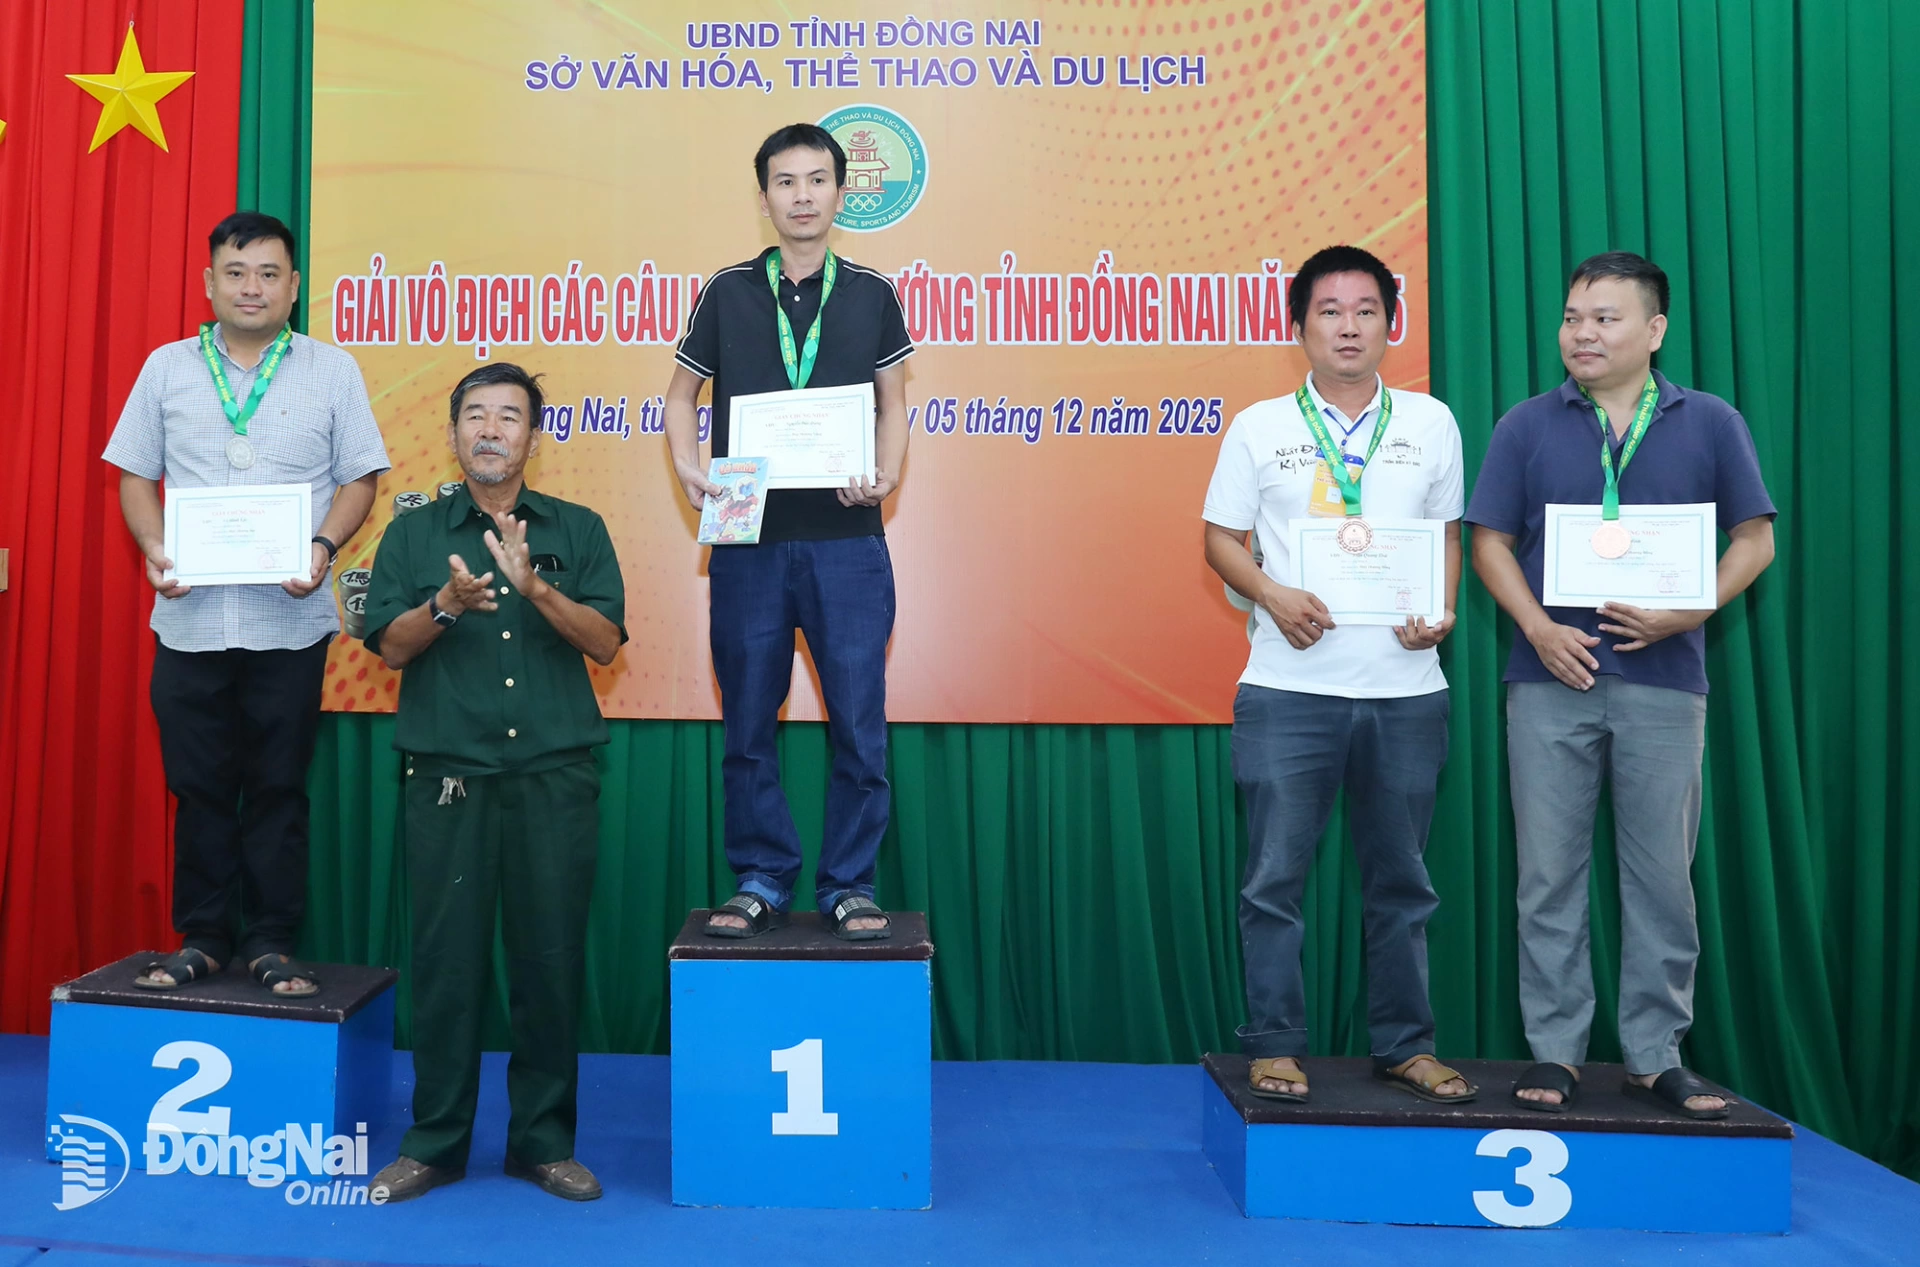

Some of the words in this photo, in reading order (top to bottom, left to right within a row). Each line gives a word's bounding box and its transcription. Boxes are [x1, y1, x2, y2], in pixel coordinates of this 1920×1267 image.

[687, 23, 780, 48] UBND
[790, 16, 866, 47] TỈNH
[875, 15, 975, 47] ĐỒNG
[985, 20, 1041, 46] NAI
[525, 55, 583, 90] SỞ
[591, 53, 668, 89] VĂN
[681, 52, 773, 93] HÓA,
[784, 52, 860, 87] THỂ
[870, 57, 977, 87] THAO
[987, 50, 1042, 86] VÀ
[1053, 56, 1105, 86] DU
[1118, 56, 1205, 92] LỊCH
[840, 113, 860, 123] THAO
[873, 114, 884, 122] DU
[884, 117, 900, 130] LỊCH
[911, 147, 920, 161] NAI
[860, 217, 888, 228] SPORTS
[888, 209, 901, 221] AND
[900, 183, 920, 211] TOURISM
[334, 254, 398, 344] GIẢI
[406, 262, 448, 344] VÔ
[455, 276, 532, 358] ĐỊCH
[540, 262, 606, 344] CÁC
[614, 262, 680, 344] CÂU
[983, 252, 1060, 343] TỈNH
[1067, 252, 1160, 344] ĐỒNG
[1169, 275, 1227, 343] NAI
[580, 396, 630, 439] Nai,
[925, 397, 957, 434] 05
[965, 396, 1043, 443] tháng
[1052, 397, 1083, 434] 12
[1090, 397, 1150, 434] năm
[1157, 397, 1223, 434] 2025
[149, 1041, 232, 1136] 2
[771, 1038, 838, 1136] 1
[1472, 1128, 1573, 1228] 3
